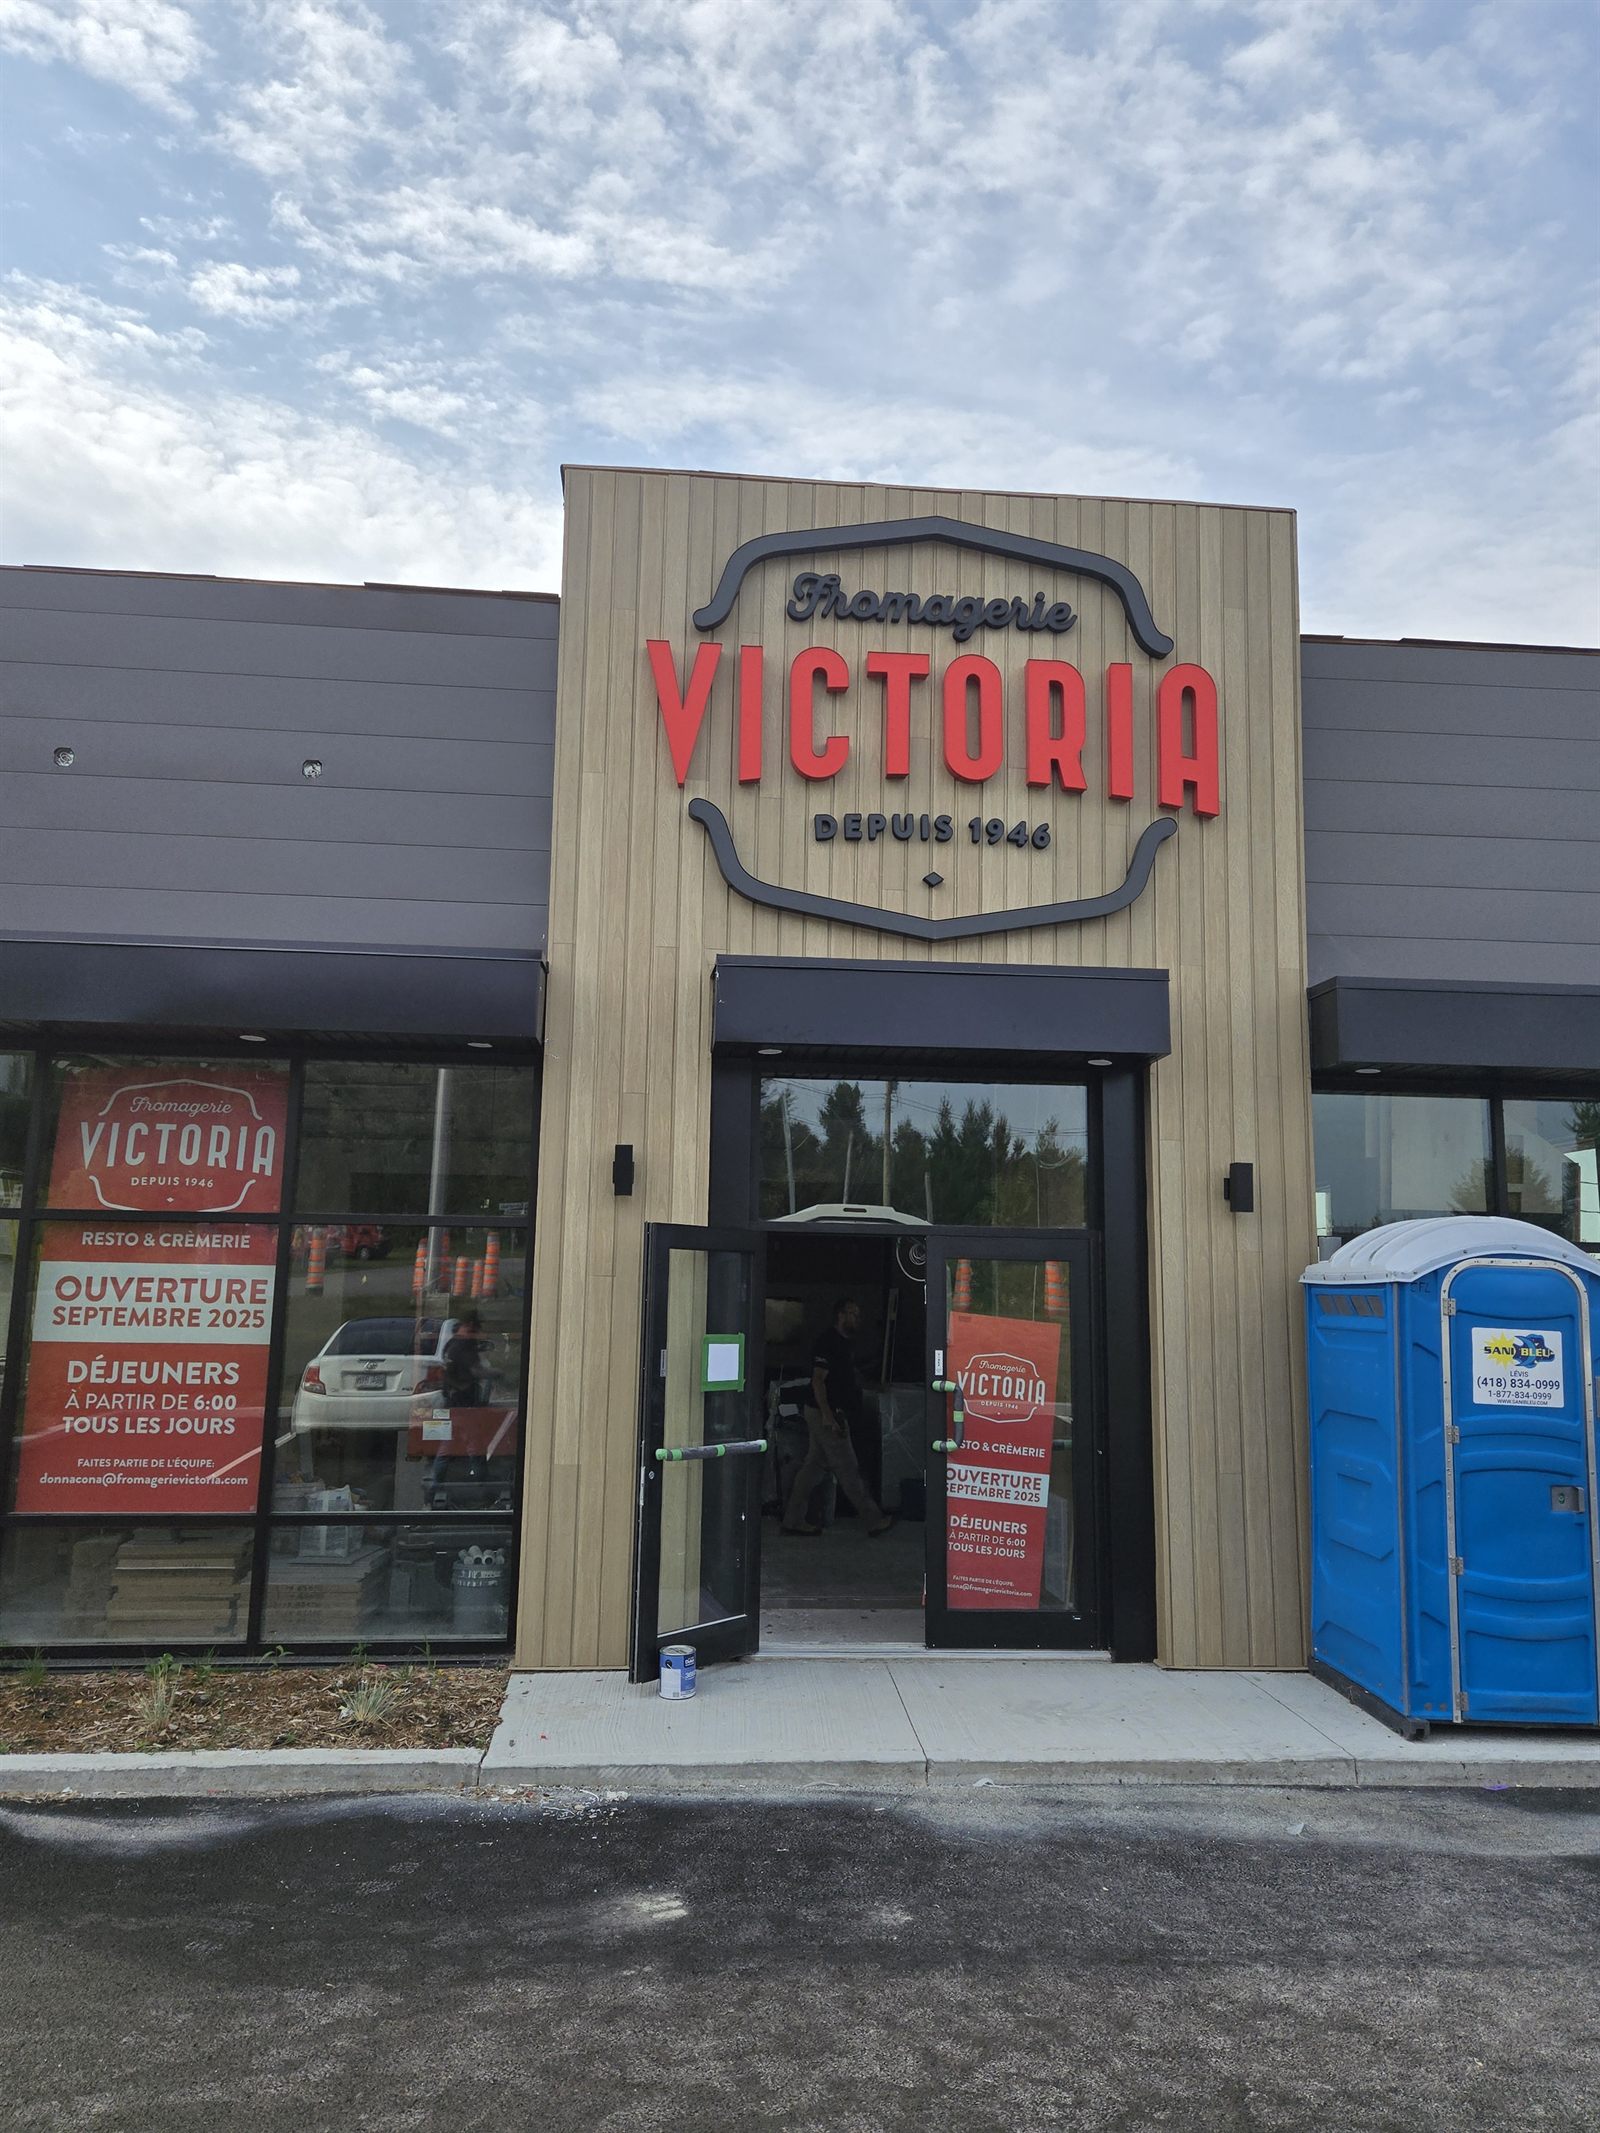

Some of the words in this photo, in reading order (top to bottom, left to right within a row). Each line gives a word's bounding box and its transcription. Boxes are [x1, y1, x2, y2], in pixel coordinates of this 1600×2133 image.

[787, 572, 1077, 642] Fromagerie
[646, 639, 1220, 819] VICTORIA
[814, 813, 954, 843] DEPUIS
[968, 816, 1051, 849] 1946
[130, 1096, 233, 1117] Fromagerie
[80, 1121, 276, 1177] VICTORIA
[131, 1177, 180, 1186] DEPUIS
[185, 1177, 214, 1188] 1946
[82, 1231, 139, 1247] RESTO
[143, 1232, 156, 1247] &
[159, 1230, 251, 1249] CRÈMERIE
[55, 1275, 268, 1305] OUVERTURE
[52, 1305, 202, 1328] SEPTEMBRE
[207, 1309, 265, 1328] 2025
[1484, 1346, 1514, 1355] SANI
[1521, 1347, 1550, 1358] BLEU
[67, 1355, 240, 1385] DÉJEUNERS
[979, 1360, 1026, 1374] Fromagerie
[1510, 1370, 1529, 1378] LÉVIS
[957, 1370, 1045, 1406] VICTORIA
[1477, 1376, 1507, 1389] (418)
[1510, 1378, 1560, 1390] 834-0999
[65, 1389, 80, 1409] À
[85, 1393, 154, 1410] PARTIR
[161, 1395, 188, 1410] DE
[194, 1395, 237, 1411] 6:00
[1488, 1390, 1552, 1401] 1-877-834-0999
[62, 1416, 119, 1434] TOUS
[125, 1417, 161, 1434] LES
[165, 1417, 235, 1434] JOURS
[982, 1442, 990, 1451] &
[992, 1443, 1045, 1458] CRÈMERIE
[77, 1458, 111, 1468] FAITES
[113, 1459, 149, 1468] PARTIE
[151, 1459, 165, 1468] DE
[40, 1472, 248, 1489] donnacona@fromagerievictoria.com
[947, 1468, 1042, 1491] OUVERTURE
[1014, 1491, 1040, 1503] 2025
[950, 1513, 1028, 1535] DÉJEUNERS
[949, 1529, 957, 1539] À
[958, 1532, 990, 1543] PARTIR
[992, 1536, 1005, 1545] DE
[1006, 1538, 1026, 1547] 6:00
[947, 1541, 974, 1553] TOUS
[975, 1545, 992, 1555] LES
[993, 1548, 1025, 1559] JOURS
